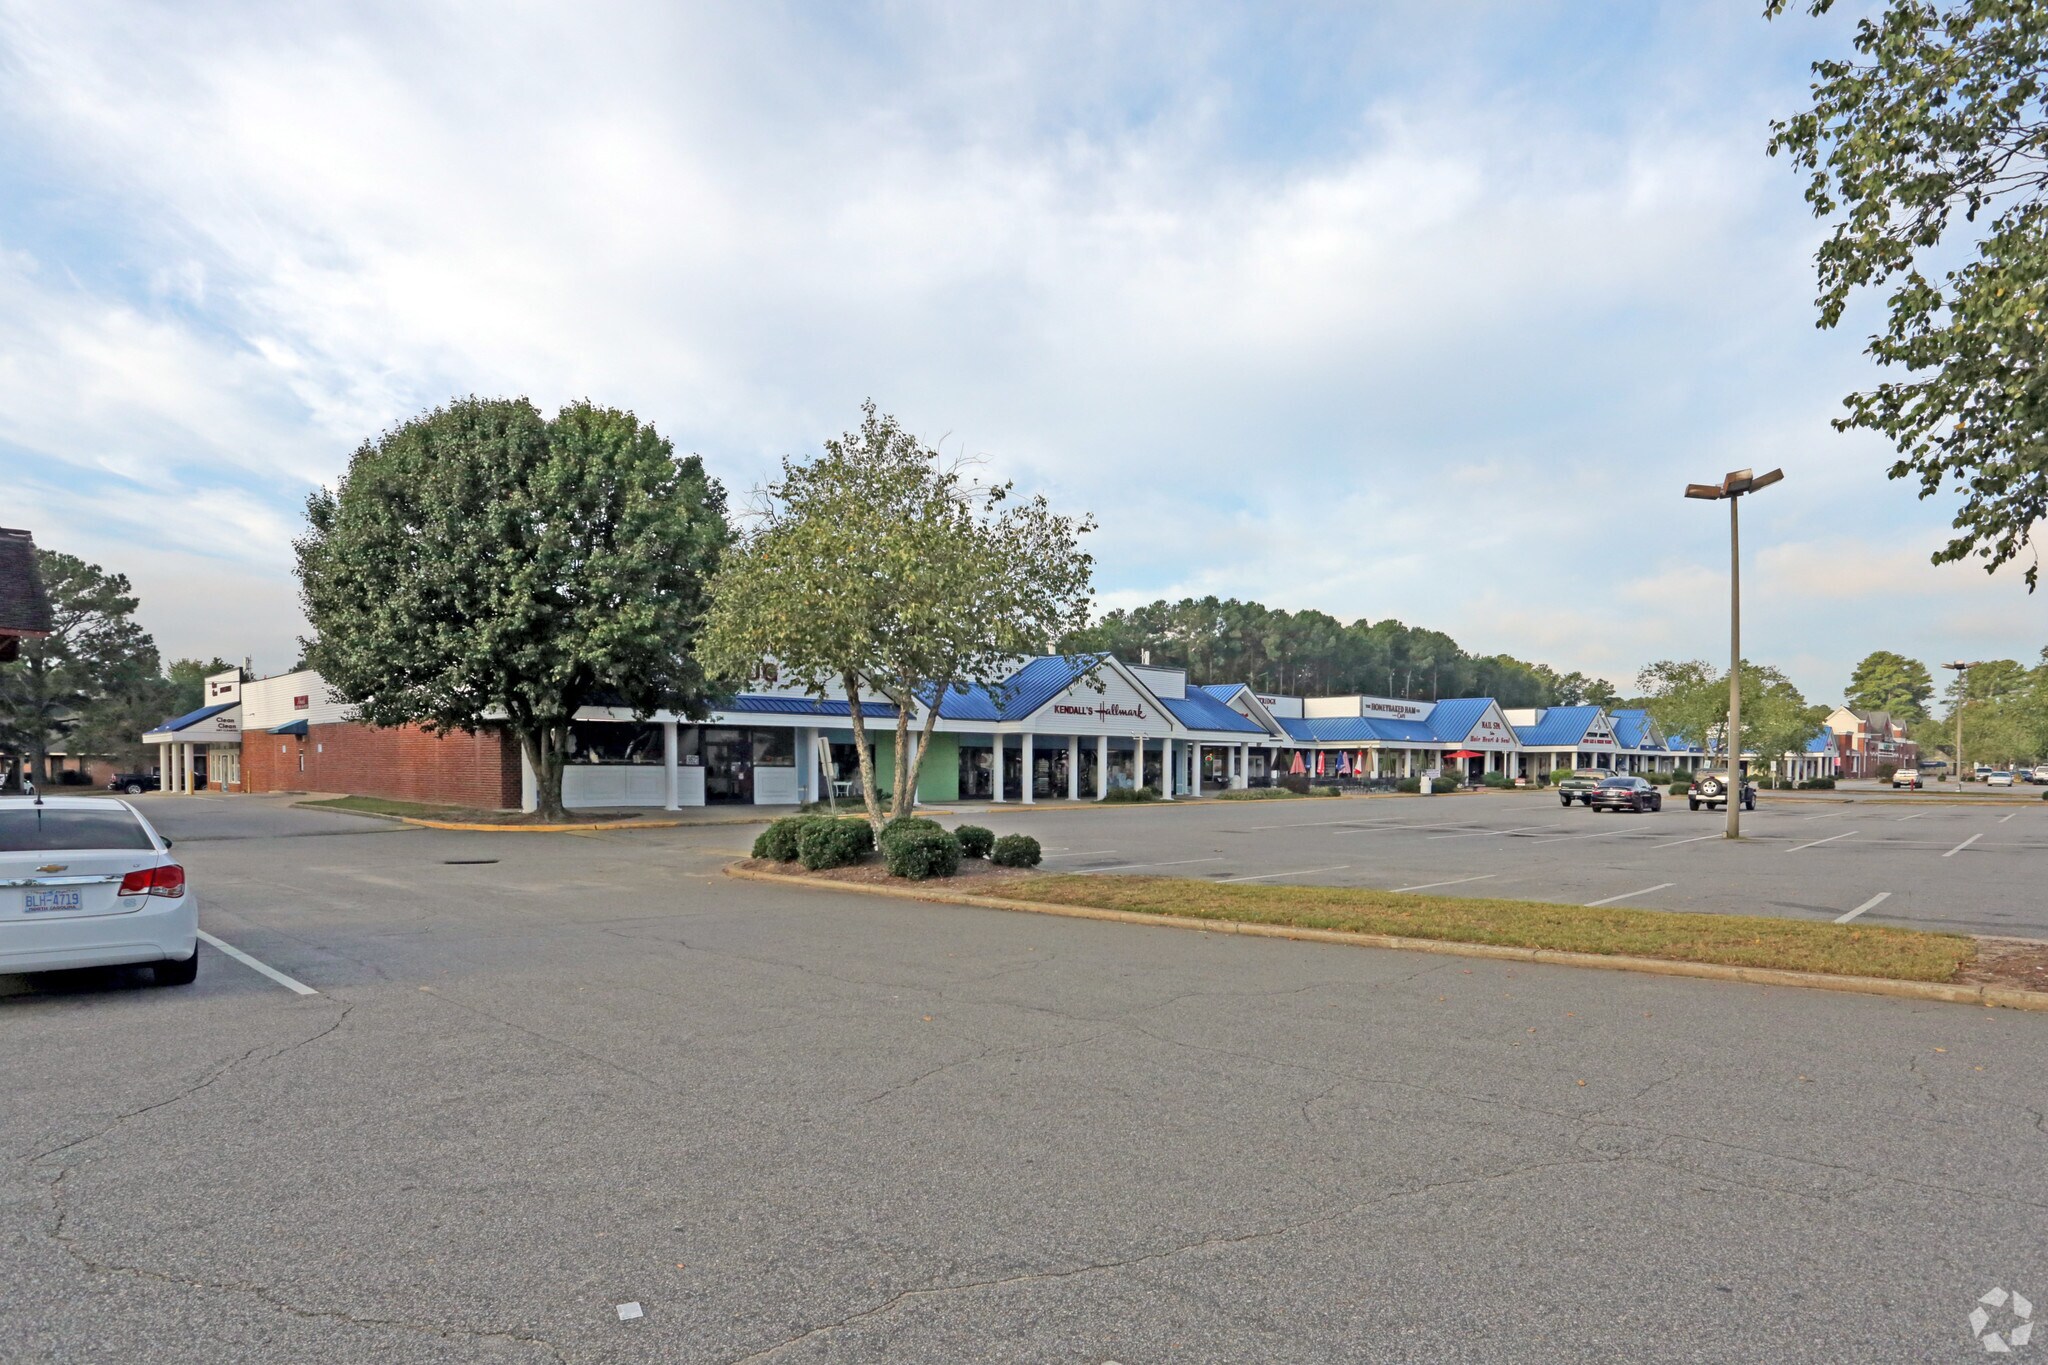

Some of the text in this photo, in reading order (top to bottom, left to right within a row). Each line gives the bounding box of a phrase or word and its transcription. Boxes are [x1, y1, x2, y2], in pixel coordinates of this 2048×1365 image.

[1054, 701, 1146, 723] KENDALL'S Hallmark
[25, 894, 79, 907] BLH-4719
